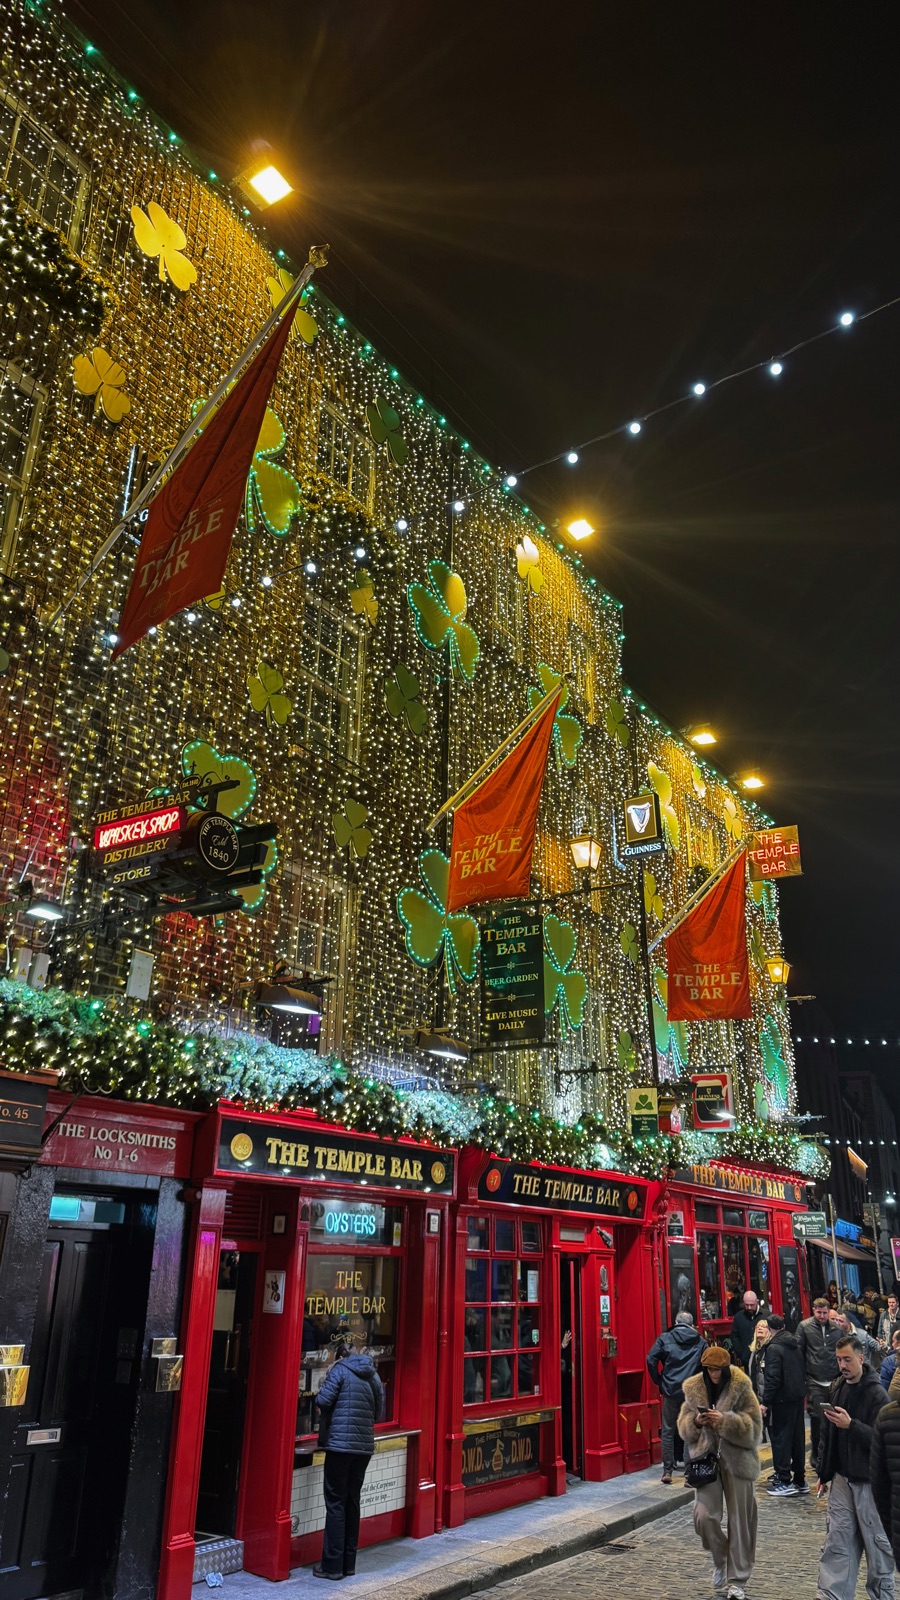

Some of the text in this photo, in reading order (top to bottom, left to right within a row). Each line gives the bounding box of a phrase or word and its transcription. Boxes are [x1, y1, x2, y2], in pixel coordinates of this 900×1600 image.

[97, 790, 191, 824] THE TEMPLE BAR
[98, 811, 180, 848] WHISKEY SHOP
[759, 833, 782, 845] THE
[104, 838, 170, 864] DISTILLERY
[208, 846, 229, 862] 1840
[454, 836, 522, 868] TEMPLE
[625, 842, 662, 856] GUINNESS
[749, 844, 798, 860] TEMPLE
[113, 866, 152, 884] STORE
[460, 858, 496, 880] BAR
[761, 862, 786, 874] BAR
[503, 916, 522, 926] THE
[484, 924, 540, 943] TEMPLE
[496, 942, 527, 956] BAR
[693, 964, 720, 974] THE
[485, 973, 539, 987] BEER GARDEN
[673, 972, 742, 987] TEMPLE
[690, 987, 724, 1000] BAR
[486, 1008, 538, 1021] LIVE MUSIC
[498, 1021, 525, 1031] DAILY
[14, 1107, 29, 1120] 45
[57, 1122, 176, 1150] THE LOCKSMITHS
[94, 1145, 139, 1162] No 1-6
[266, 1137, 310, 1168] THE
[314, 1146, 386, 1176] TEMPLE
[390, 1156, 424, 1182] BAR
[691, 1164, 786, 1199] THE TEMPLE BAR
[513, 1174, 541, 1196] THE
[544, 1178, 594, 1203] TEMPLE
[595, 1186, 620, 1207] BAR
[325, 1212, 376, 1235] OYSTERS
[336, 1271, 363, 1288] THE
[307, 1296, 386, 1316] TEMPLE BAR
[511, 1437, 533, 1463] D.W.D.
[462, 1446, 484, 1474] D.W.D.
[377, 1480, 396, 1490] Carpenter
